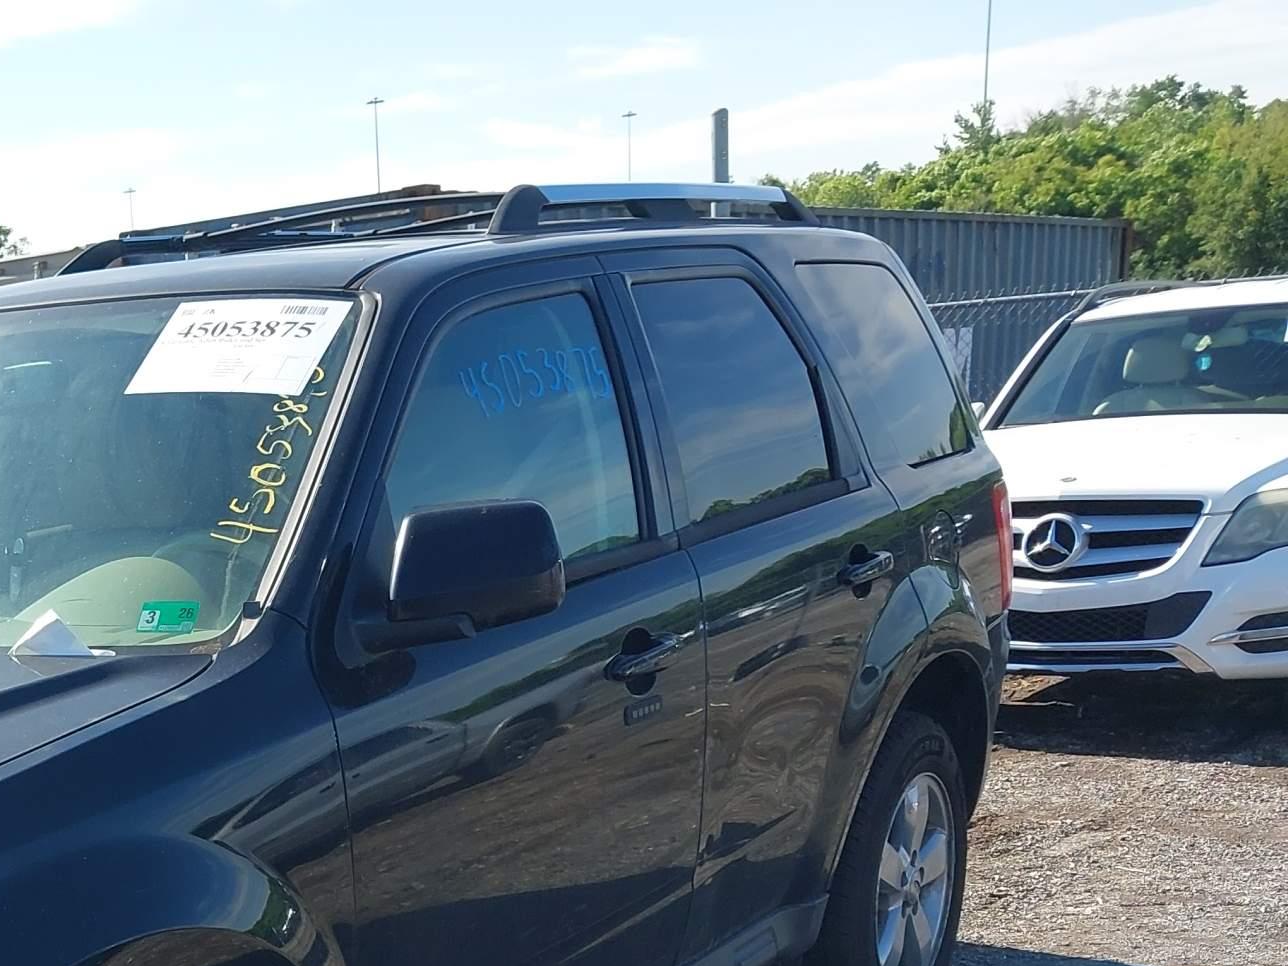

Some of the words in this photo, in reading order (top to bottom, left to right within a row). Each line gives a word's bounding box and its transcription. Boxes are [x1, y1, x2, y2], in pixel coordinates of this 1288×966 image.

[176, 320, 318, 340] 45053875
[459, 346, 611, 418] 45053875
[209, 365, 328, 545] 450538
[145, 610, 157, 624] 3
